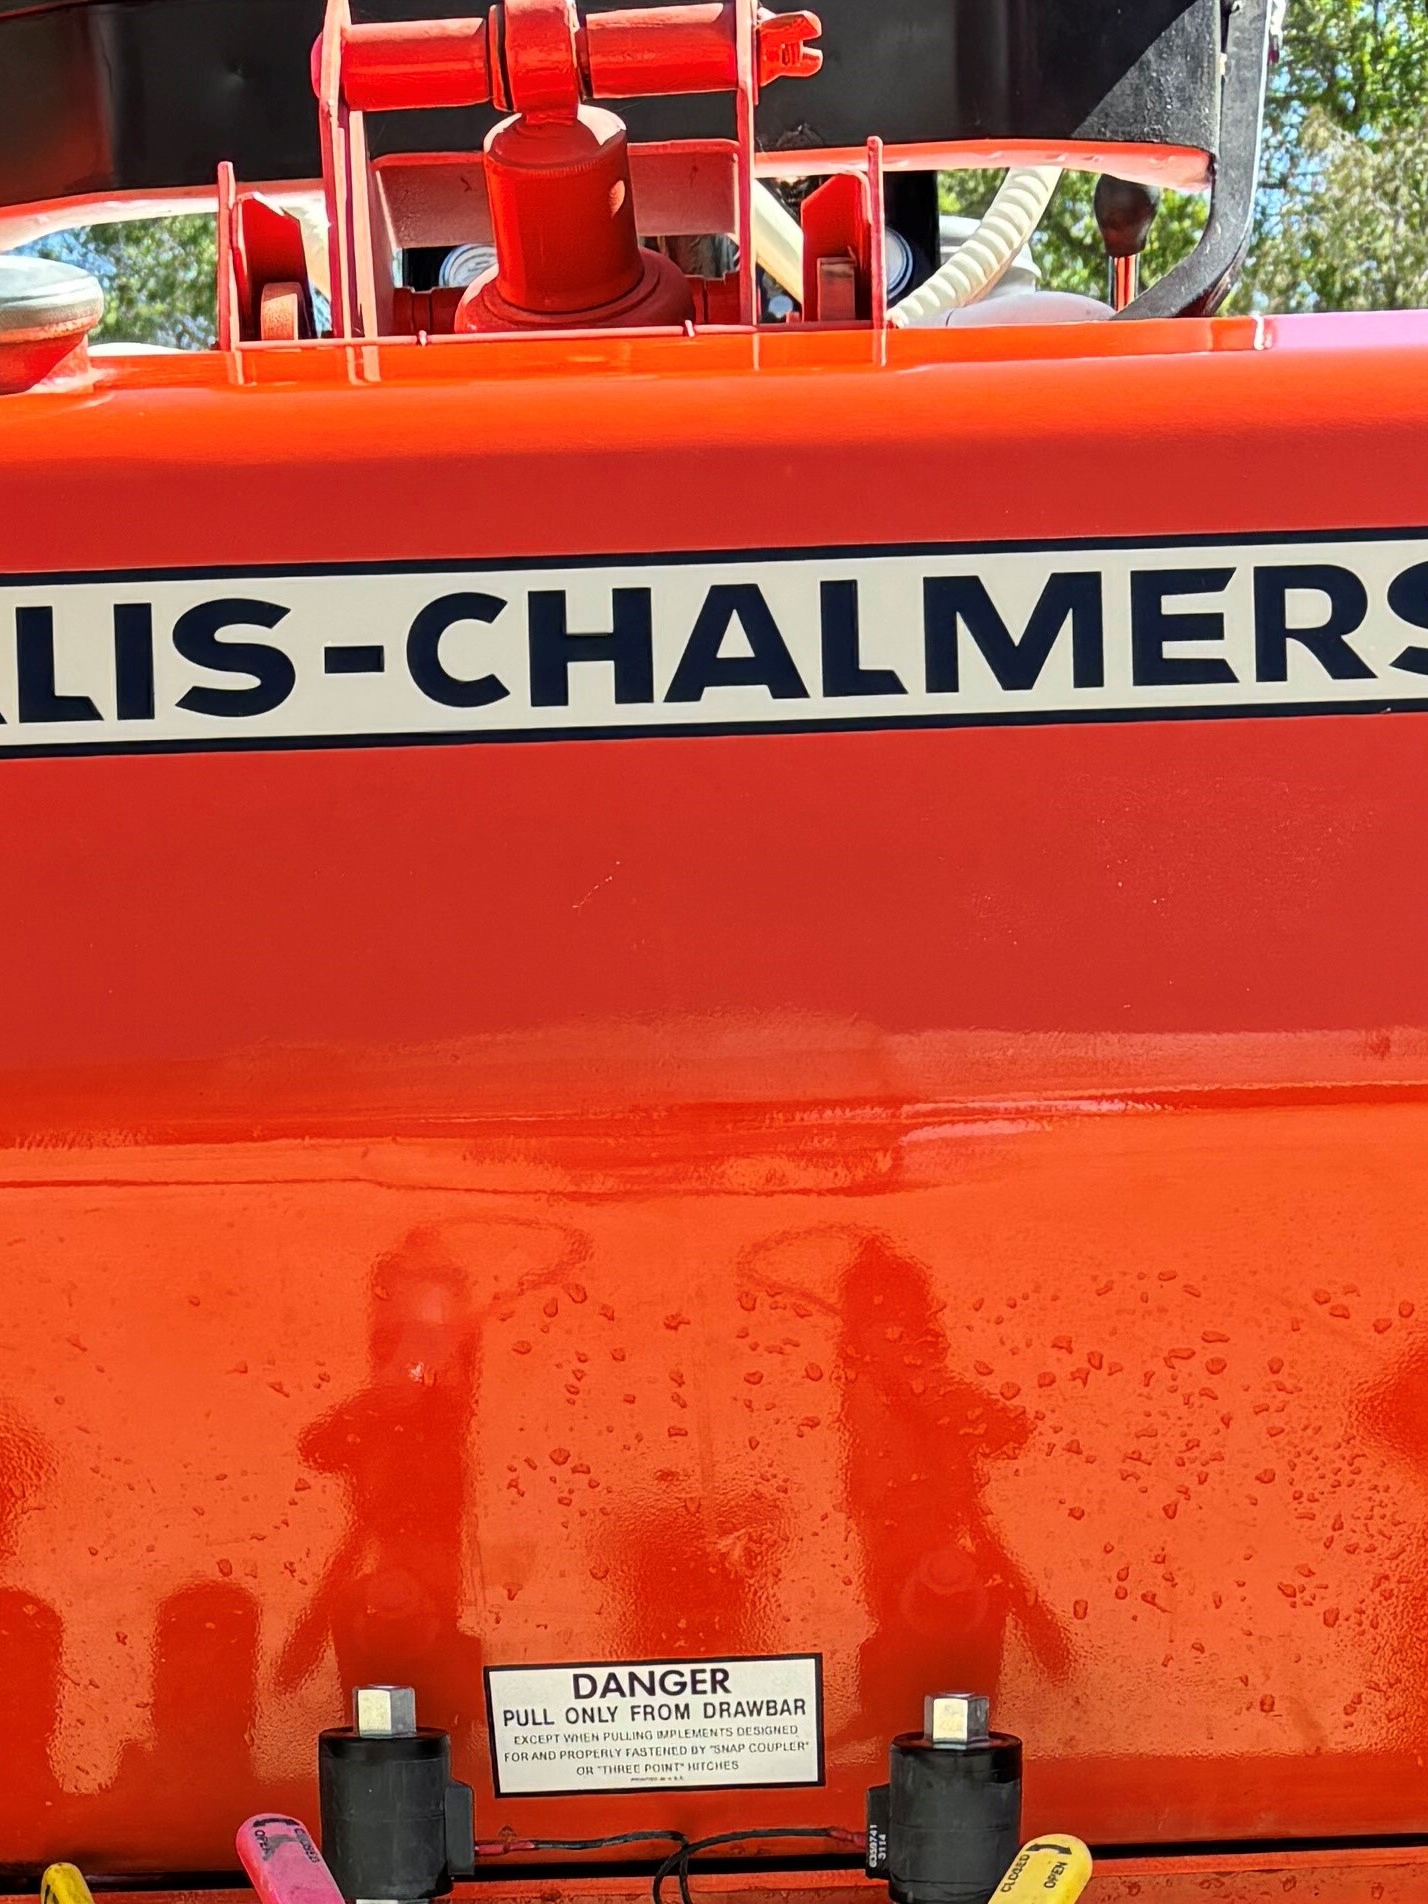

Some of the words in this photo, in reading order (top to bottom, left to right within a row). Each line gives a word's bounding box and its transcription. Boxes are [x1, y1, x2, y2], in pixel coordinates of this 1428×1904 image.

[573, 1668, 732, 1700] DANGER
[503, 1708, 555, 1727] PULL
[565, 1705, 618, 1725] ONLY
[630, 1702, 690, 1722] FROM
[703, 1698, 807, 1719] DRAWBAR
[514, 1733, 560, 1745] EXCEPT
[563, 1732, 599, 1743] WHEN
[603, 1730, 653, 1742] PULLING
[656, 1727, 733, 1739] IMPLEMENTS
[737, 1724, 799, 1736] DESIGNED
[504, 1751, 529, 1763] FOR
[531, 1750, 556, 1761] AND
[559, 1748, 622, 1760] PROPERLY
[625, 1745, 688, 1758] FASTENED
[691, 1745, 706, 1755] BY
[576, 1766, 594, 1776] OR
[688, 1760, 740, 1771] HITCHES
[1000, 1853, 1031, 1893] CLOSED
[1043, 1861, 1068, 1889] OPEN
